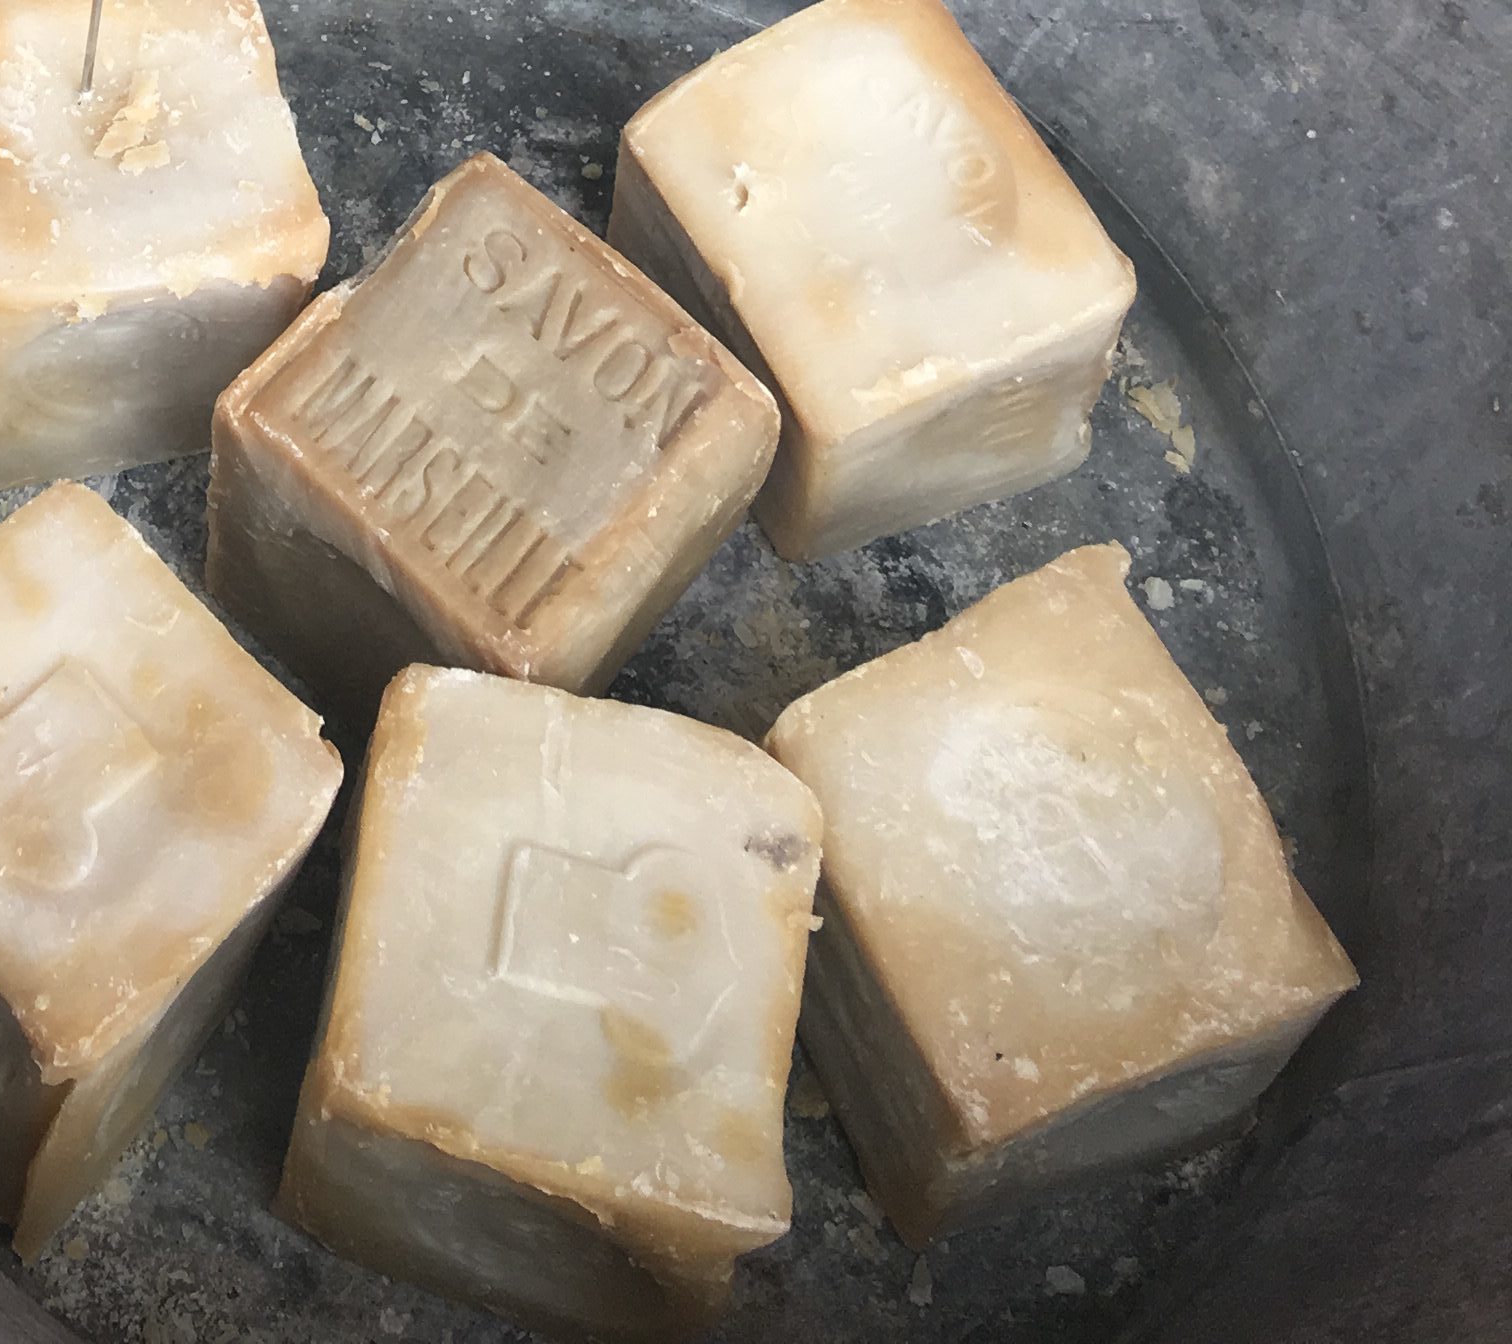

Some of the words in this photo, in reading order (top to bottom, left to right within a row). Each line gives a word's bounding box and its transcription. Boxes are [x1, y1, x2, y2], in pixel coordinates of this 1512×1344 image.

[456, 355, 571, 466] DE
[463, 229, 704, 452] SAVON
[290, 355, 585, 631] MARSEILLE
